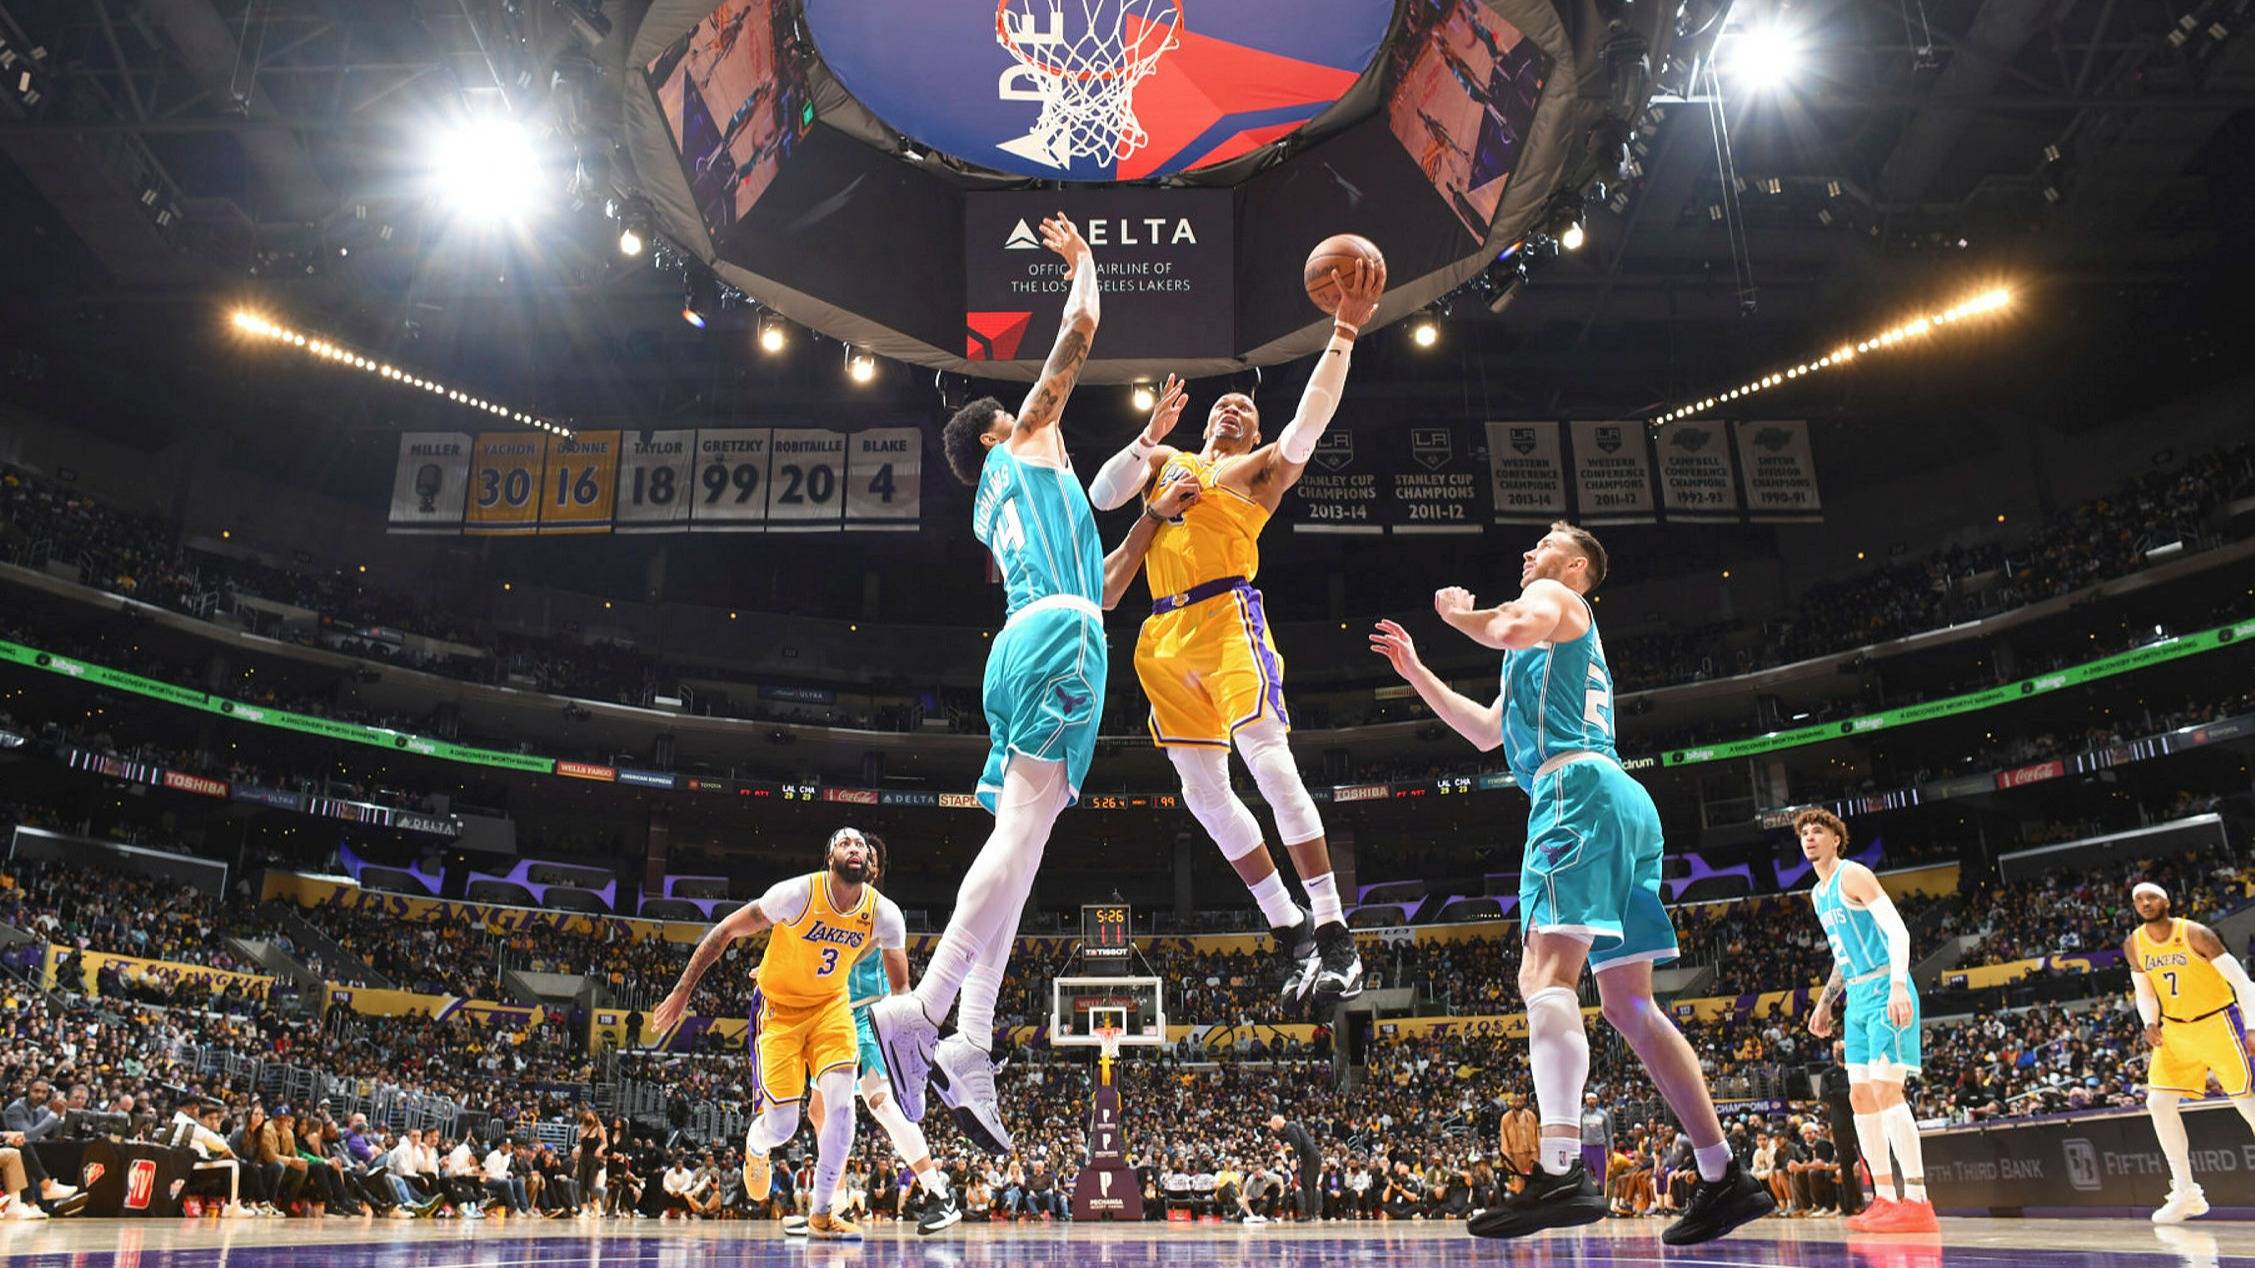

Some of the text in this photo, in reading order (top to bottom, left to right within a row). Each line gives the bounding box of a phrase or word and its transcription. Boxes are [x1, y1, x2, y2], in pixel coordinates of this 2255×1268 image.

[1028, 262, 1173, 276] OFFIC AIRLINE OF
[1011, 279, 1191, 293] THE LOS GELES LAKERS
[410, 443, 461, 457] MILLER
[634, 441, 683, 455] TAYLOR
[702, 439, 763, 453] GRETZKY
[775, 439, 843, 453] ROBITAILLE
[863, 440, 907, 452] BLAKE
[1502, 458, 1550, 468] WESTERN
[1395, 474, 1473, 486] STANLEY CUP
[1580, 468, 1645, 478] CONFERENCE
[478, 466, 532, 509] 30
[556, 465, 600, 508] 16
[633, 465, 676, 505] 18
[702, 463, 760, 504] 99
[777, 463, 835, 504] 20
[868, 463, 896, 503] 4
[1299, 474, 1376, 487] STANLEY CUP
[1500, 481, 1557, 491] CHAMPIONS
[1585, 480, 1644, 490] CHAMPIONS
[1297, 486, 1376, 500] CHAMPIONS
[1395, 486, 1475, 500] CHAMPIONS
[1310, 503, 1367, 519] 2013-14
[1409, 504, 1465, 519] 2011-12
[561, 763, 612, 777] WELLS FARGO
[1621, 757, 1654, 769] ctrum
[166, 772, 227, 796] TOSHIBA
[620, 774, 648, 782] AMERICAN
[896, 795, 936, 804] DELTA
[1311, 792, 1328, 800] LTRA
[1334, 787, 1388, 801] TOSHIBA
[1161, 796, 1175, 807] 99
[413, 819, 455, 836] DELTA
[1764, 813, 1799, 828] STAP
[1096, 910, 1124, 923] 5:26
[802, 919, 865, 948] LAKERS
[1101, 924, 1121, 945] 11
[1098, 948, 1128, 956] TISSOT
[1828, 934, 1850, 965] 2
[817, 947, 840, 977] 3
[2145, 952, 2189, 971] LAKERS
[2163, 972, 2178, 996] 7
[1715, 1101, 1770, 1114] CHAMONS
[2103, 1151, 2162, 1175] FIFTH
[2189, 1149, 2237, 1173] HIRD
[1926, 1164, 1952, 1183] FTH
[1953, 1160, 1997, 1182] THIRD
[2000, 1157, 2044, 1180] BANK
